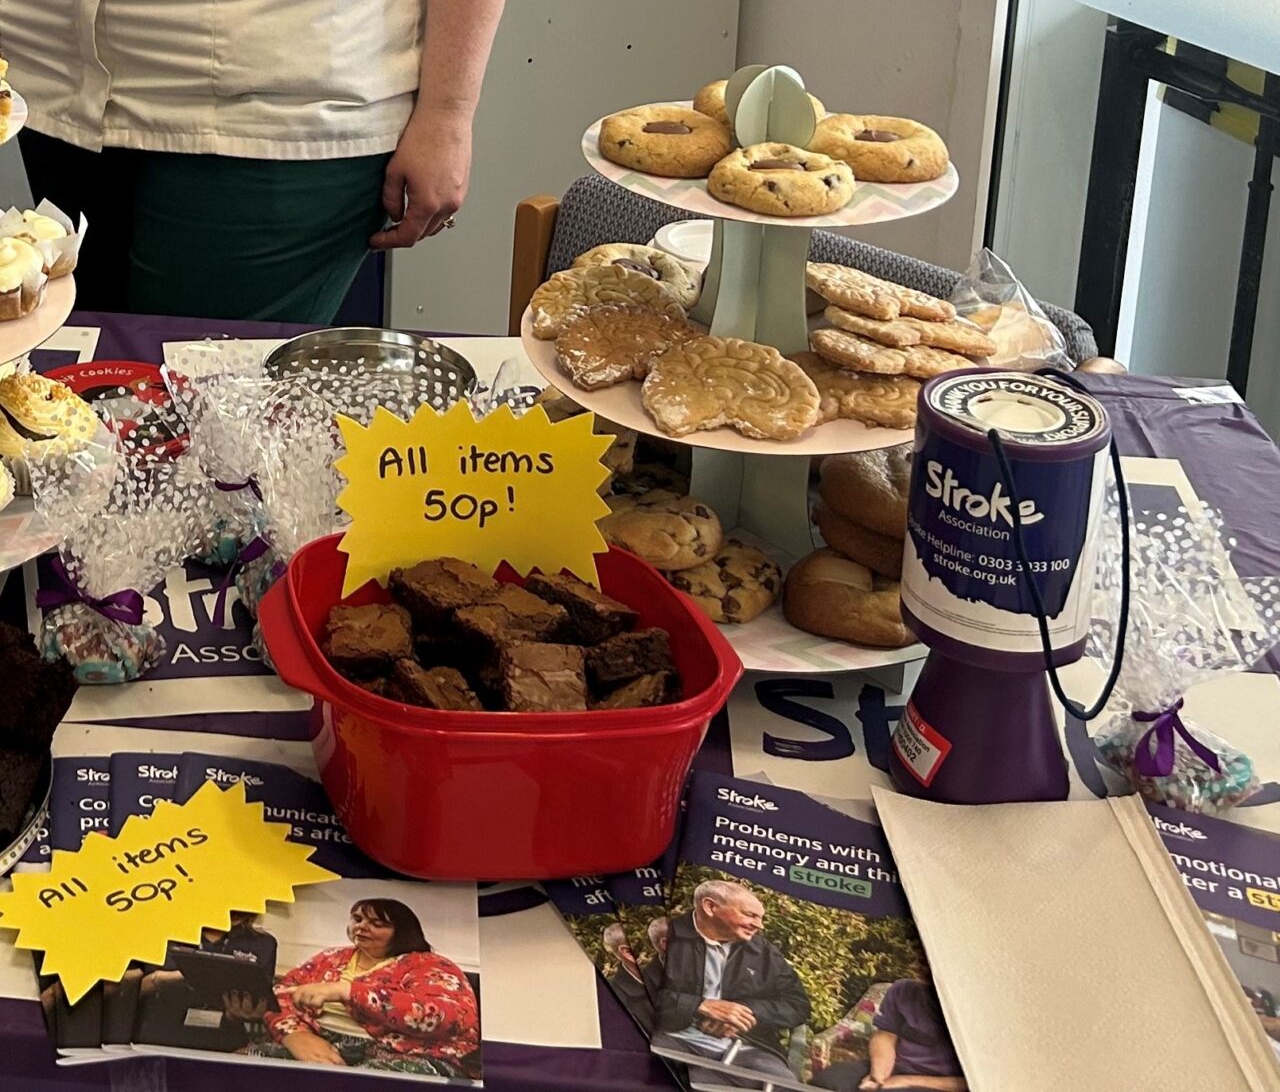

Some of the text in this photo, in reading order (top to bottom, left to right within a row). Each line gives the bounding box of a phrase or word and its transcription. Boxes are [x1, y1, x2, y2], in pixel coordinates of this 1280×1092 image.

[957, 381, 997, 393] YOU
[998, 380, 1038, 395] FOR
[1039, 388, 1083, 413] YOUR
[379, 445, 554, 479] All items
[424, 486, 515, 528] 50p!
[926, 460, 1044, 528] Stroke
[938, 509, 1010, 541] Association
[927, 532, 975, 563] Helpline:
[979, 555, 1013, 571] 0303
[1050, 559, 1070, 571] 100
[933, 553, 1017, 586] stroke.org.uk
[205, 767, 264, 786] Stroke
[717, 787, 779, 811] Stroke
[715, 815, 881, 863] Problems with
[1149, 814, 1208, 840] troke
[39, 828, 209, 908] All items
[711, 851, 866, 894] after a stroke
[713, 833, 809, 866] memory
[816, 858, 860, 876] and
[106, 864, 194, 912] 50p!
[1227, 886, 1243, 900] a
